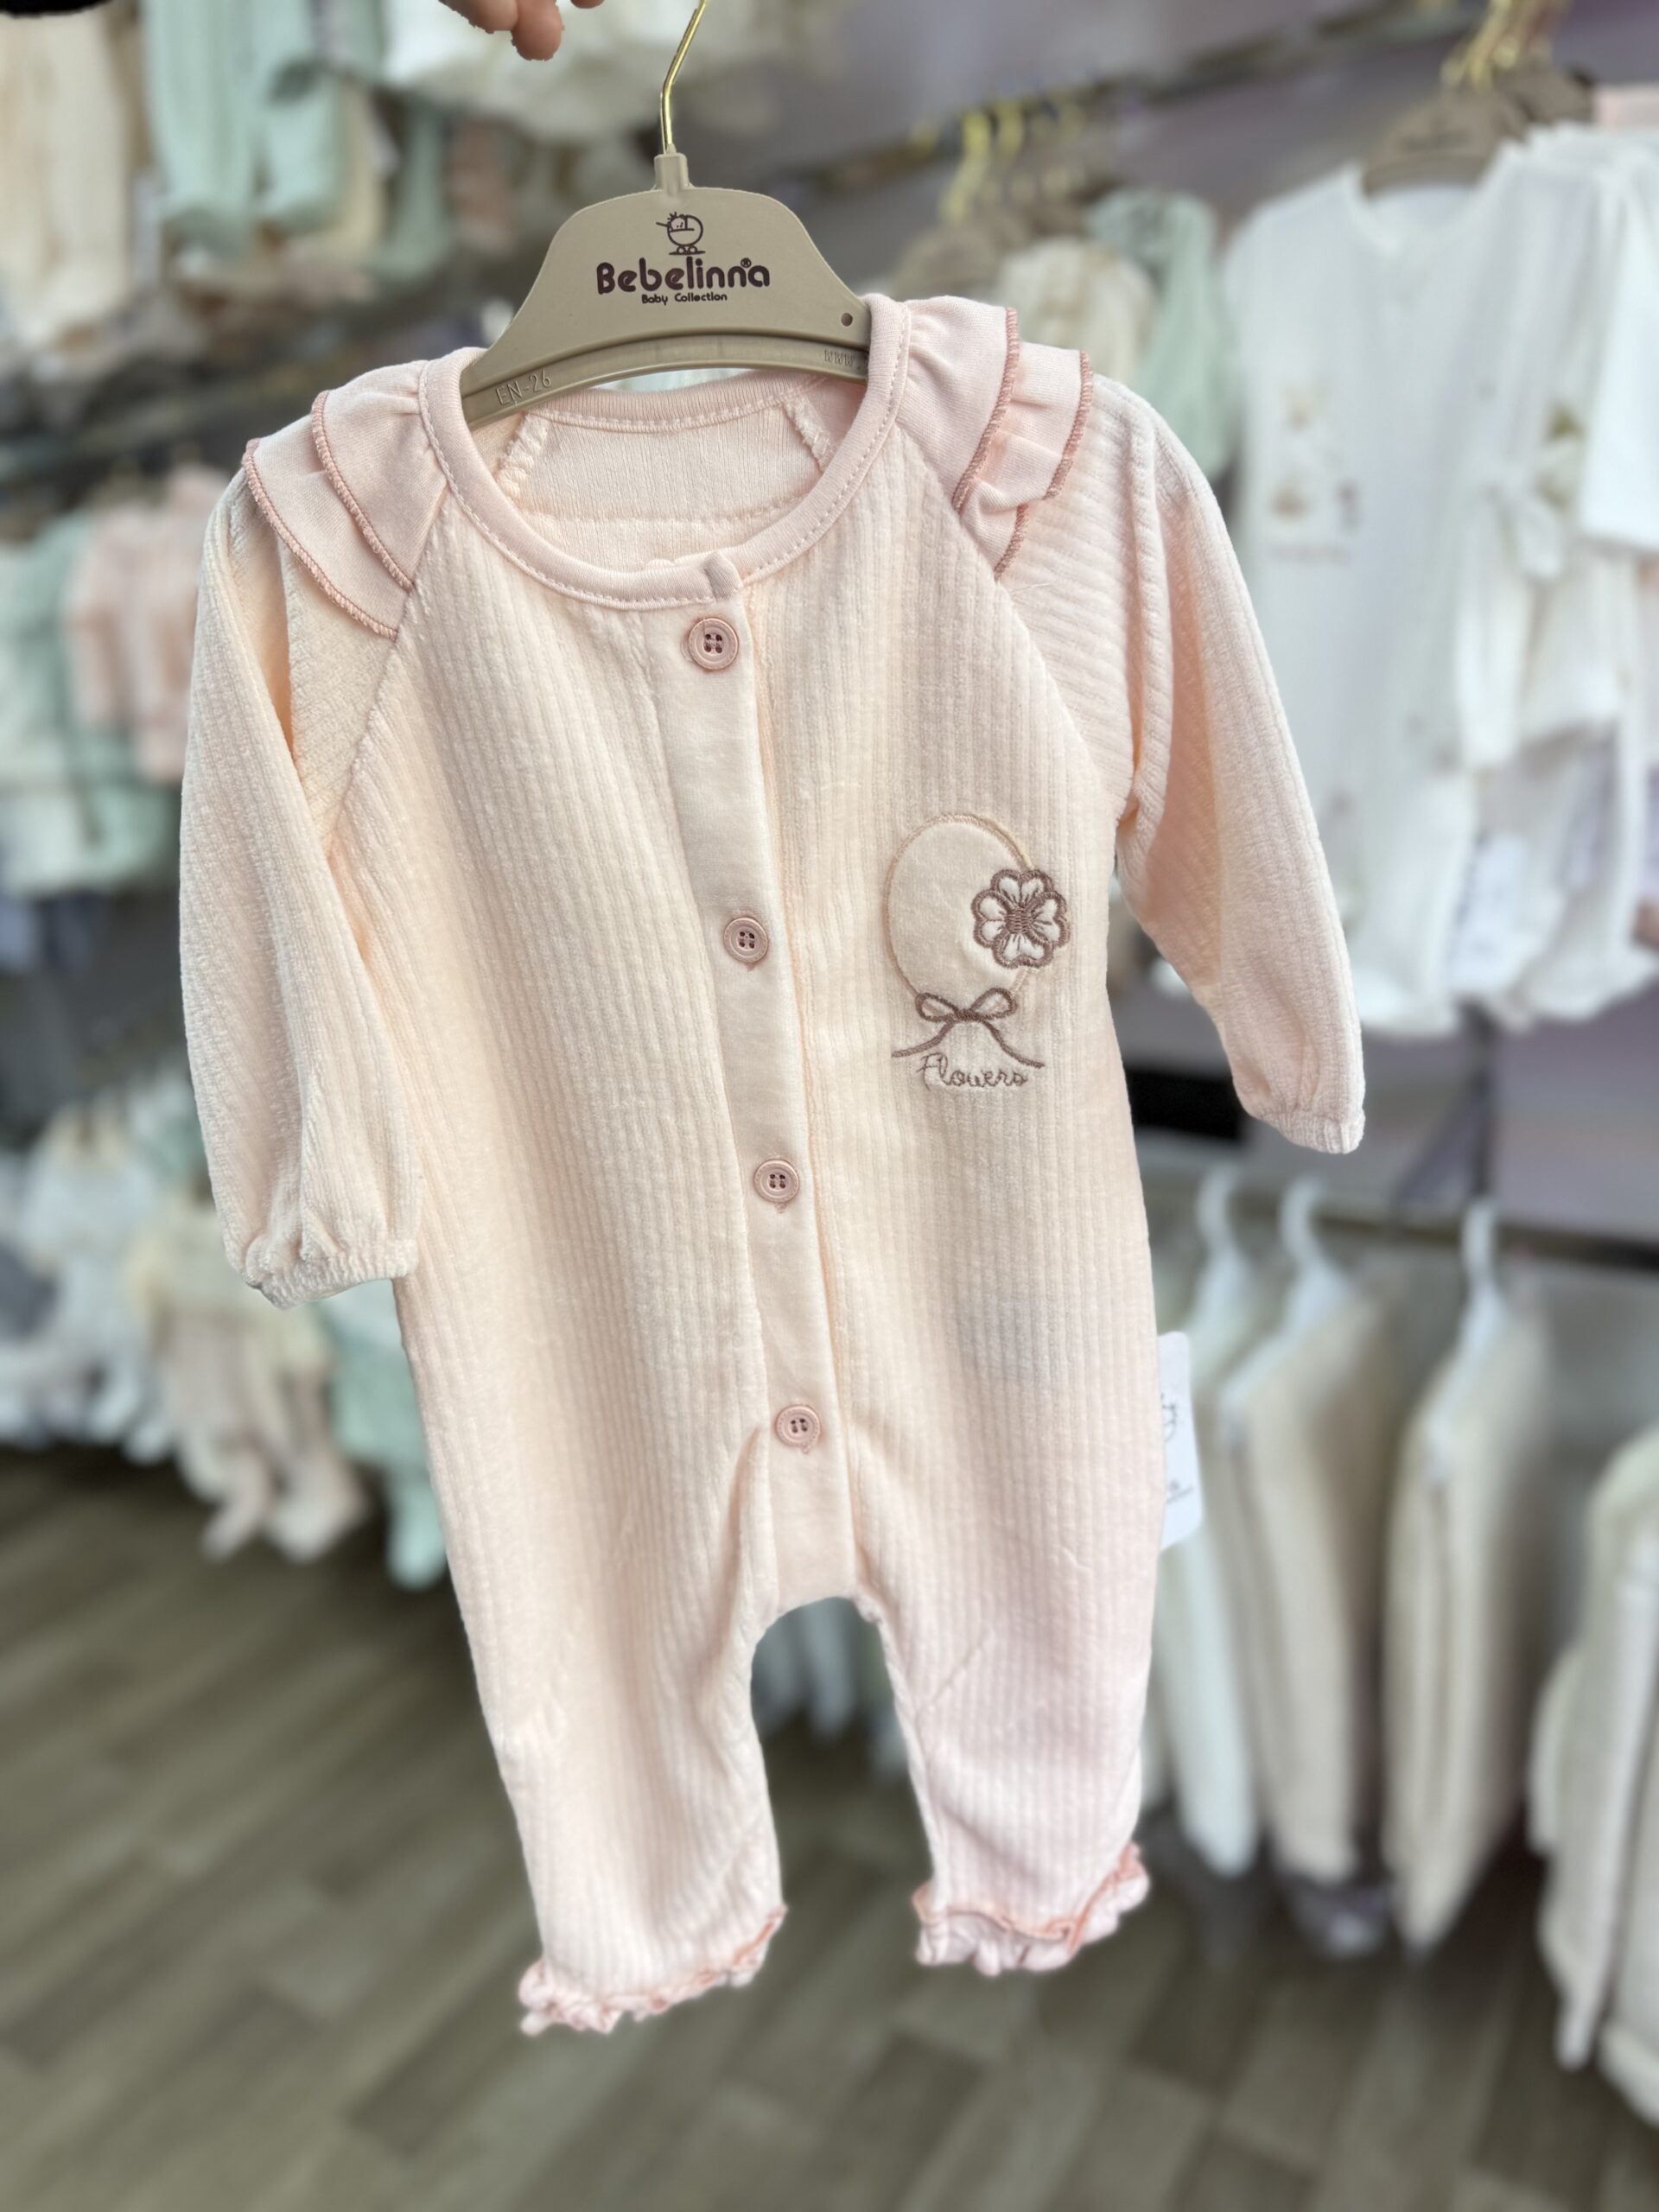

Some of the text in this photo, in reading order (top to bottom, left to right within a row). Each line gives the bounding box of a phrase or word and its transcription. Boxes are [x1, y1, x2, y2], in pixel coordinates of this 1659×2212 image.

[596, 257, 770, 295] Bebelinna
[641, 292, 728, 305] Baby Collection
[495, 369, 551, 406] EN-26
[917, 1052, 1028, 1091] Flowers
